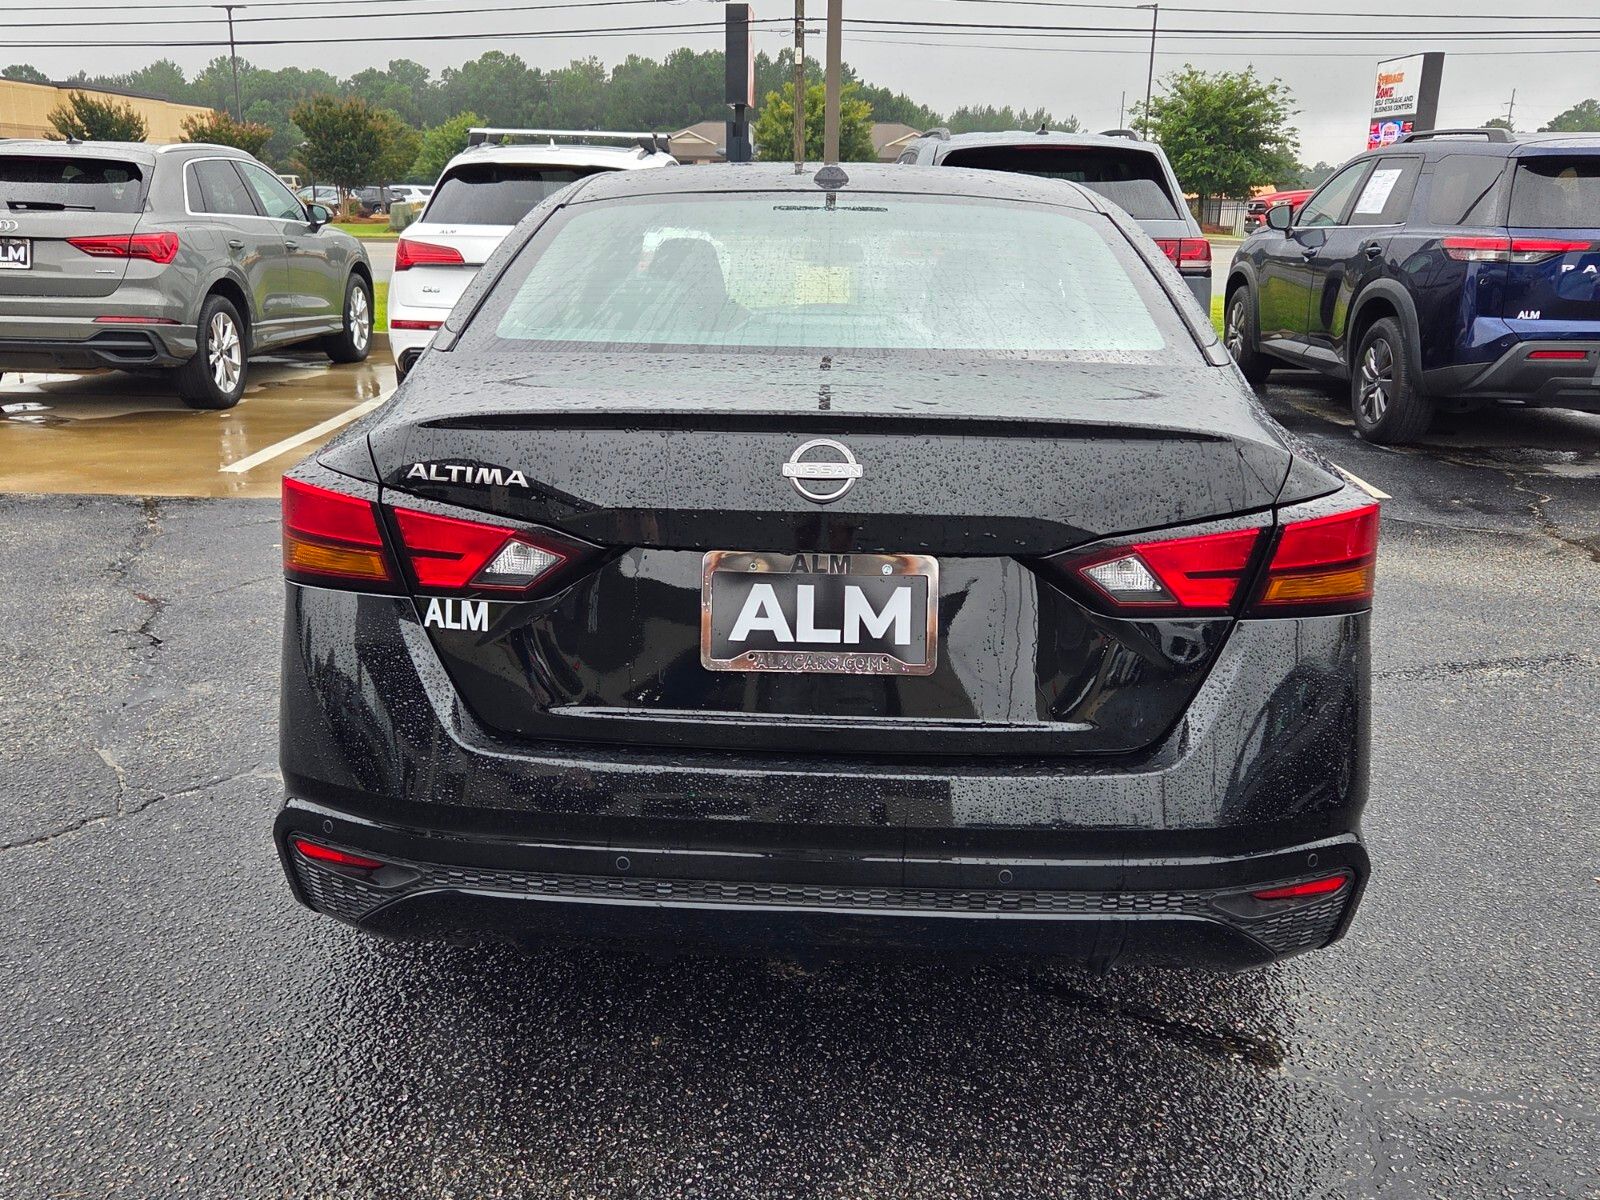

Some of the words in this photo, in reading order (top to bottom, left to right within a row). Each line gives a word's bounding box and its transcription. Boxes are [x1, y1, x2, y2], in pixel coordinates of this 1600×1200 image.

[1384, 97, 1403, 105] STORAGE
[1393, 103, 1413, 111] CENTERS
[1516, 310, 1541, 320] ALM
[406, 463, 529, 488] ALTIMA
[784, 464, 861, 476] NISSAN
[789, 554, 851, 575] ALM
[424, 598, 489, 632] ALM
[728, 583, 912, 645] ALM
[755, 654, 884, 672] ALMCARS.COM
